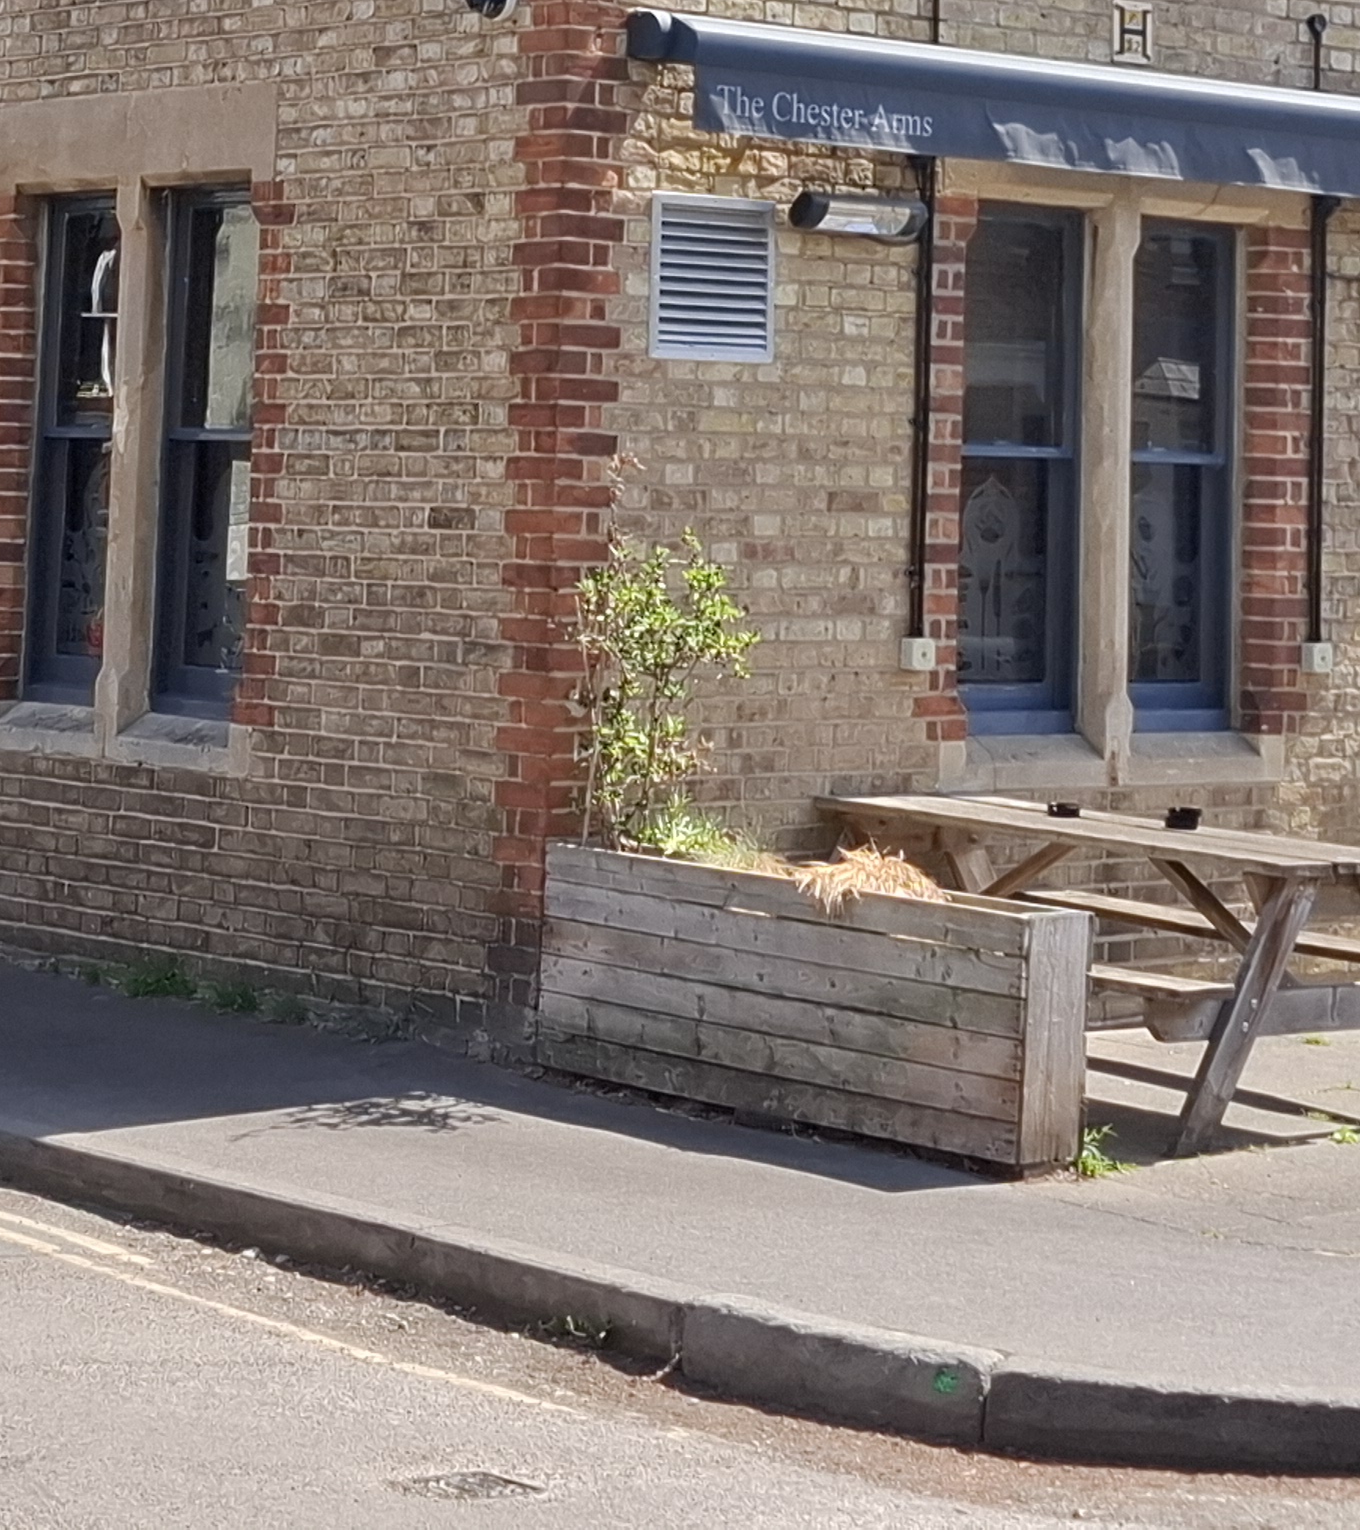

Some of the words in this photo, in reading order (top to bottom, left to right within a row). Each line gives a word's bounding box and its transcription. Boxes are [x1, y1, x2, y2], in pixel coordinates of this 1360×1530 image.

[716, 84, 765, 118] The
[771, 91, 865, 129] Chester
[870, 104, 934, 138] Arms
